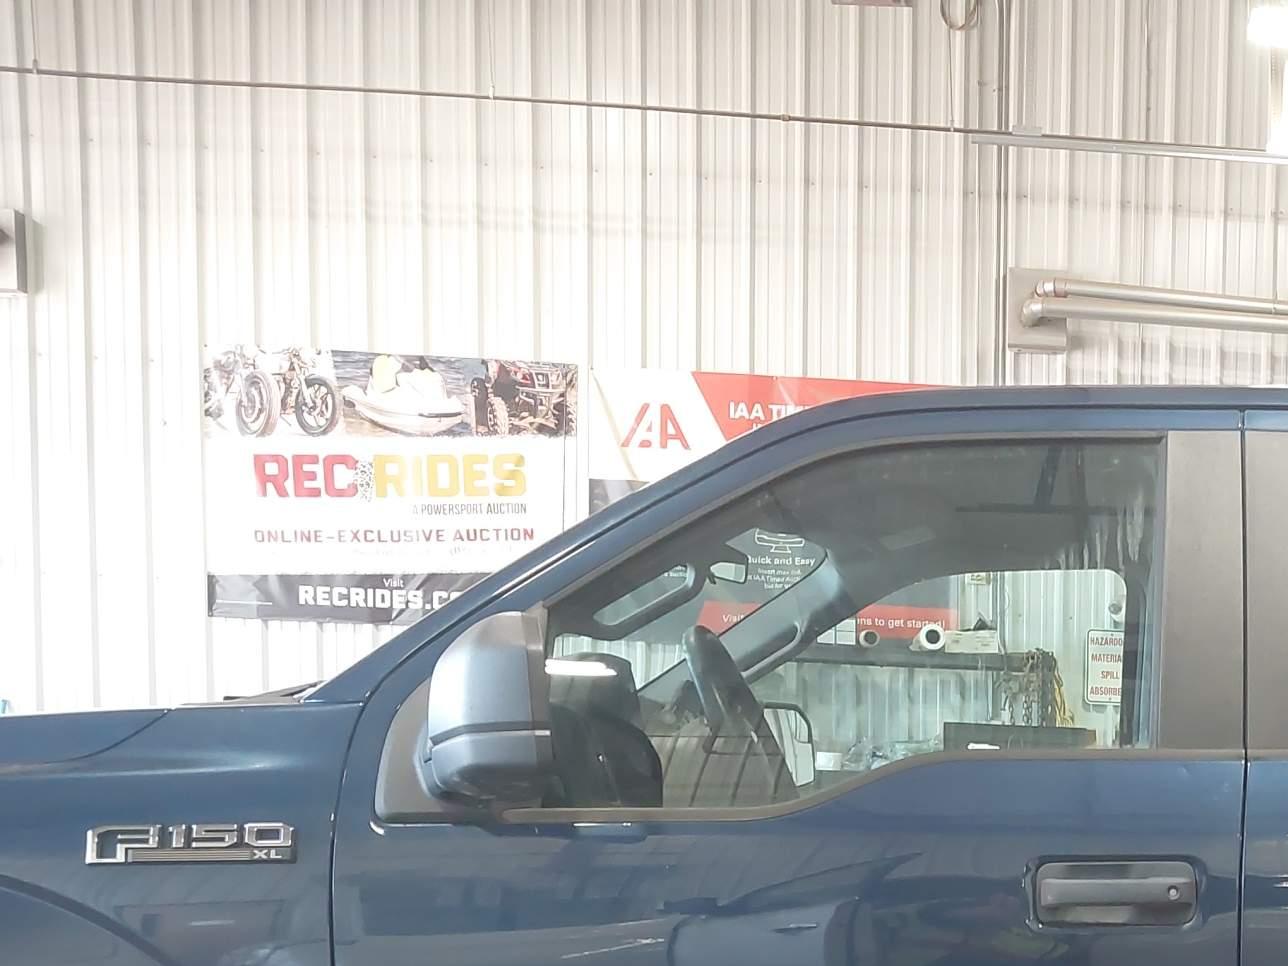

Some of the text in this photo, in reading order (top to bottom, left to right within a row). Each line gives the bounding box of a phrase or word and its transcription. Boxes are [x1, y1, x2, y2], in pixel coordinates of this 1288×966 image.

[728, 401, 766, 420] IAA
[252, 453, 527, 498] REC RIDES
[420, 503, 483, 516] POWERSPORT
[486, 502, 527, 515] AUCTION
[254, 527, 535, 544] ONLINE-EXCLUSIVE AUCTION
[774, 557, 792, 565] and
[795, 557, 815, 567] Easy
[382, 577, 404, 588] Visit
[297, 585, 462, 610] RECRIDES.C
[875, 617, 885, 626] to
[888, 619, 904, 629] get
[1089, 637, 1123, 646] HAZARDO
[1091, 653, 1122, 663] MATERIA
[1101, 670, 1120, 680] SPILL
[1089, 686, 1121, 696] ABSORBE
[253, 850, 283, 859] XL
